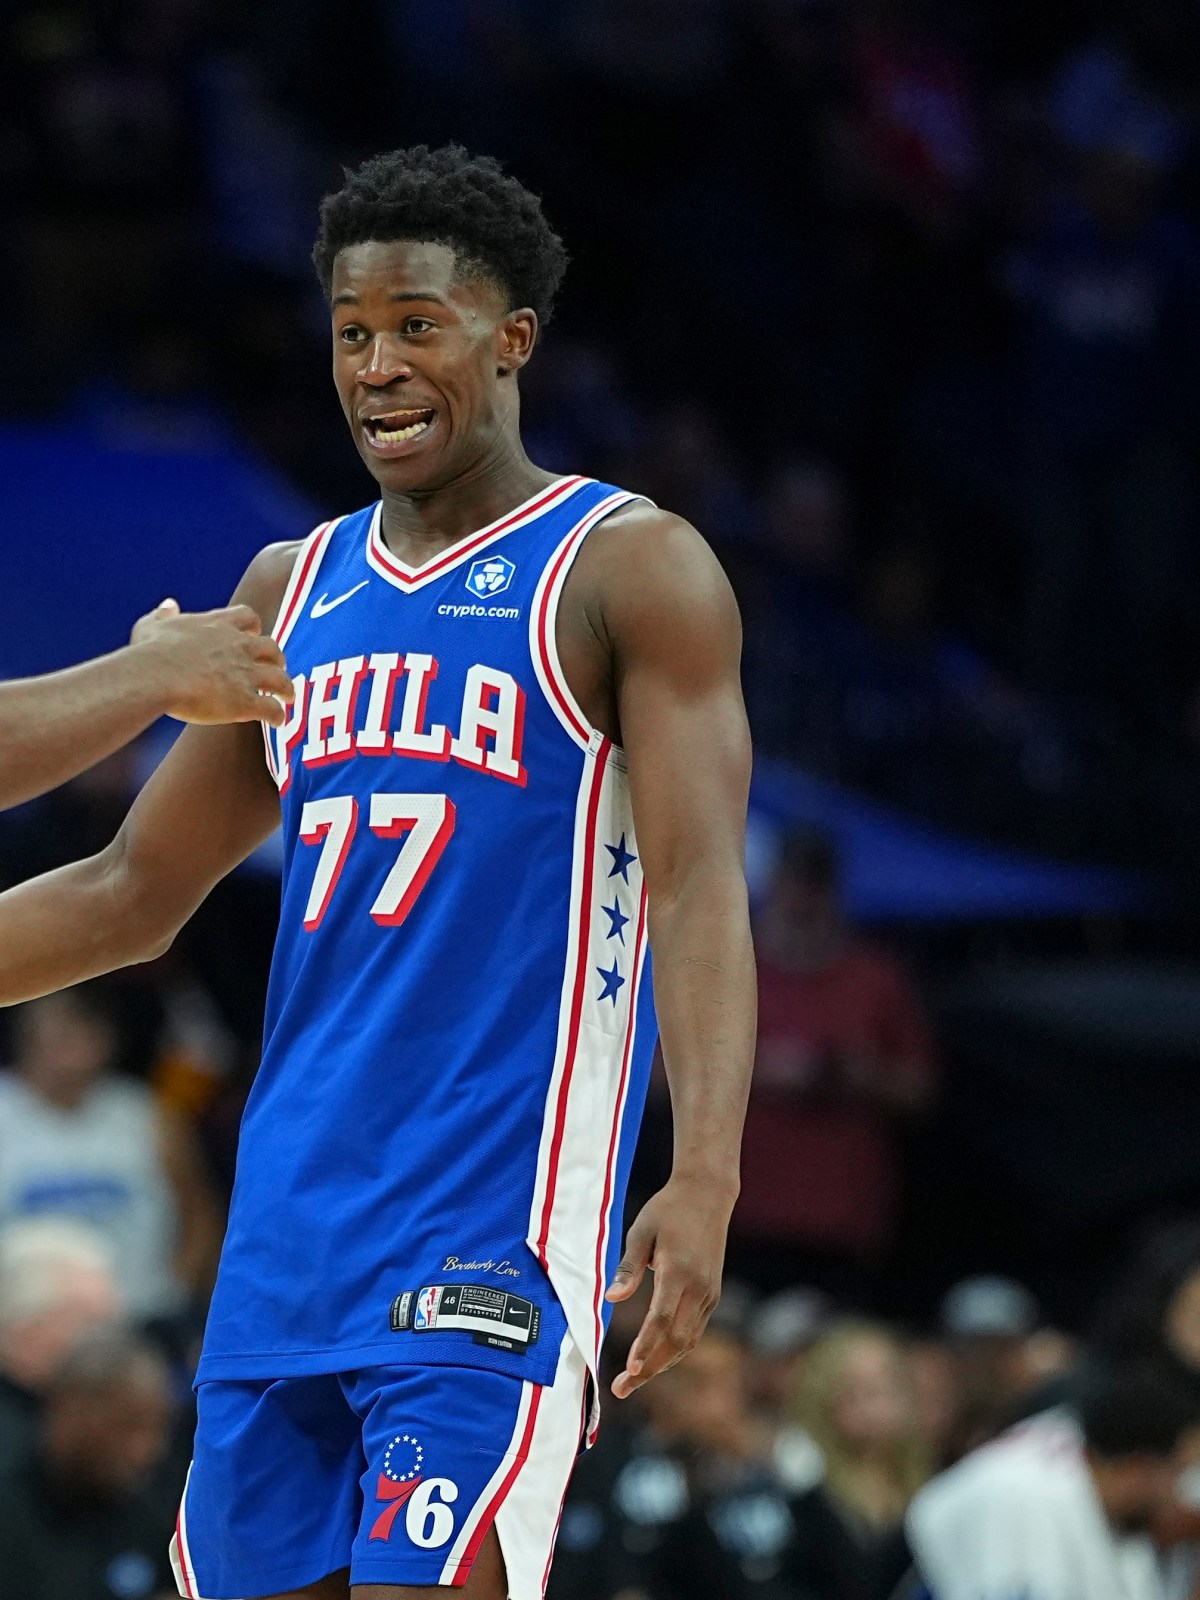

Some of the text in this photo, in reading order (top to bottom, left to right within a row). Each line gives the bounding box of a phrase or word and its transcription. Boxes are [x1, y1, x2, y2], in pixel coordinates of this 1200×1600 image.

[438, 604, 519, 619] crypto.com
[272, 653, 527, 796] PHILA
[299, 794, 456, 932] 77
[442, 1256, 520, 1278] Brotherly Love
[444, 1296, 456, 1305] 46
[463, 1288, 505, 1301] ENGINEERED
[368, 1471, 459, 1549] 76
